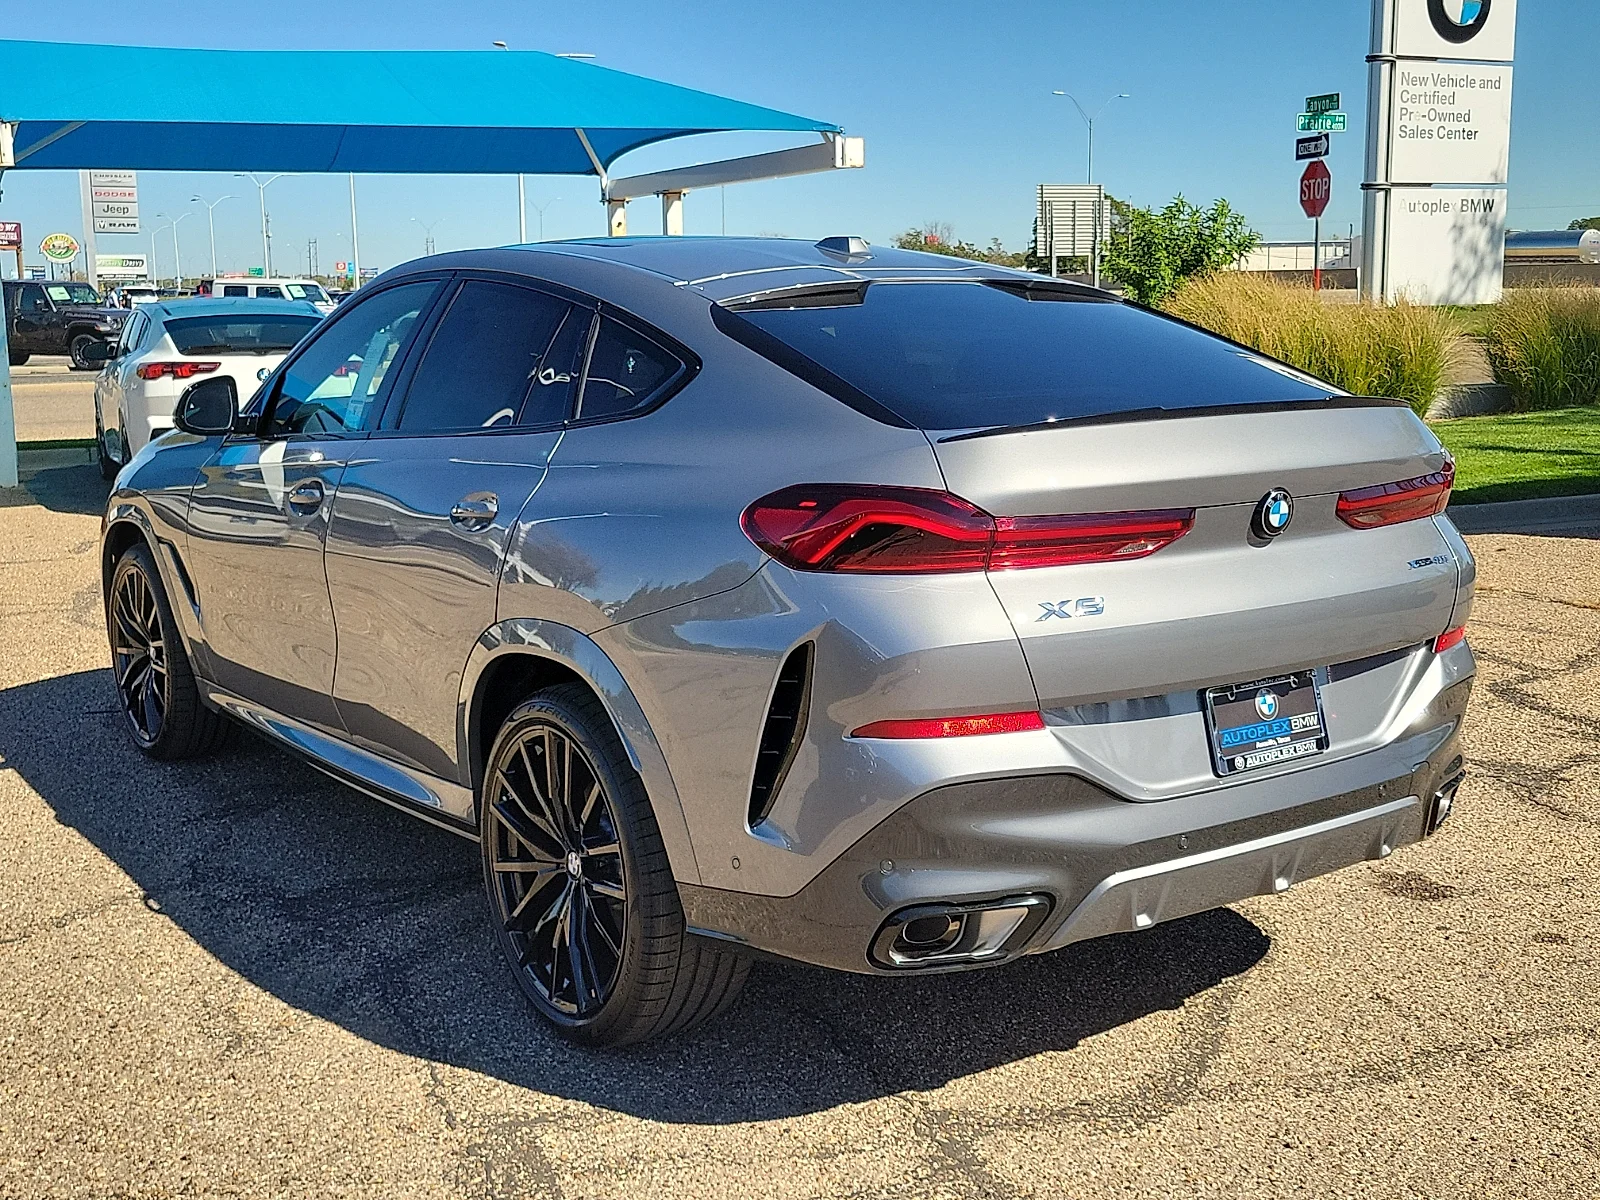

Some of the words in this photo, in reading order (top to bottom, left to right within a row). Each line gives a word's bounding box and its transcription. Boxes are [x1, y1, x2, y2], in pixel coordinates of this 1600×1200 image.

[1400, 71, 1429, 87] New
[1431, 73, 1476, 88] Vehicle
[1479, 76, 1501, 90] and
[1306, 99, 1330, 111] Canyon
[1400, 89, 1455, 105] Certified
[1299, 115, 1332, 129] Prairie
[1400, 107, 1471, 122] Pre-Owned
[1398, 124, 1434, 139] Sales
[1436, 125, 1479, 140] Center
[1301, 177, 1329, 201] STOP
[102, 204, 130, 215] Jeep
[1398, 198, 1457, 216] Autoplex
[1460, 198, 1495, 213] BMW
[1035, 597, 1104, 622] X6
[1222, 721, 1291, 746] AUTOPLEX
[1291, 714, 1318, 730] BMW
[1246, 746, 1294, 769] AUTOPLEX
[1294, 740, 1317, 754] BMW
